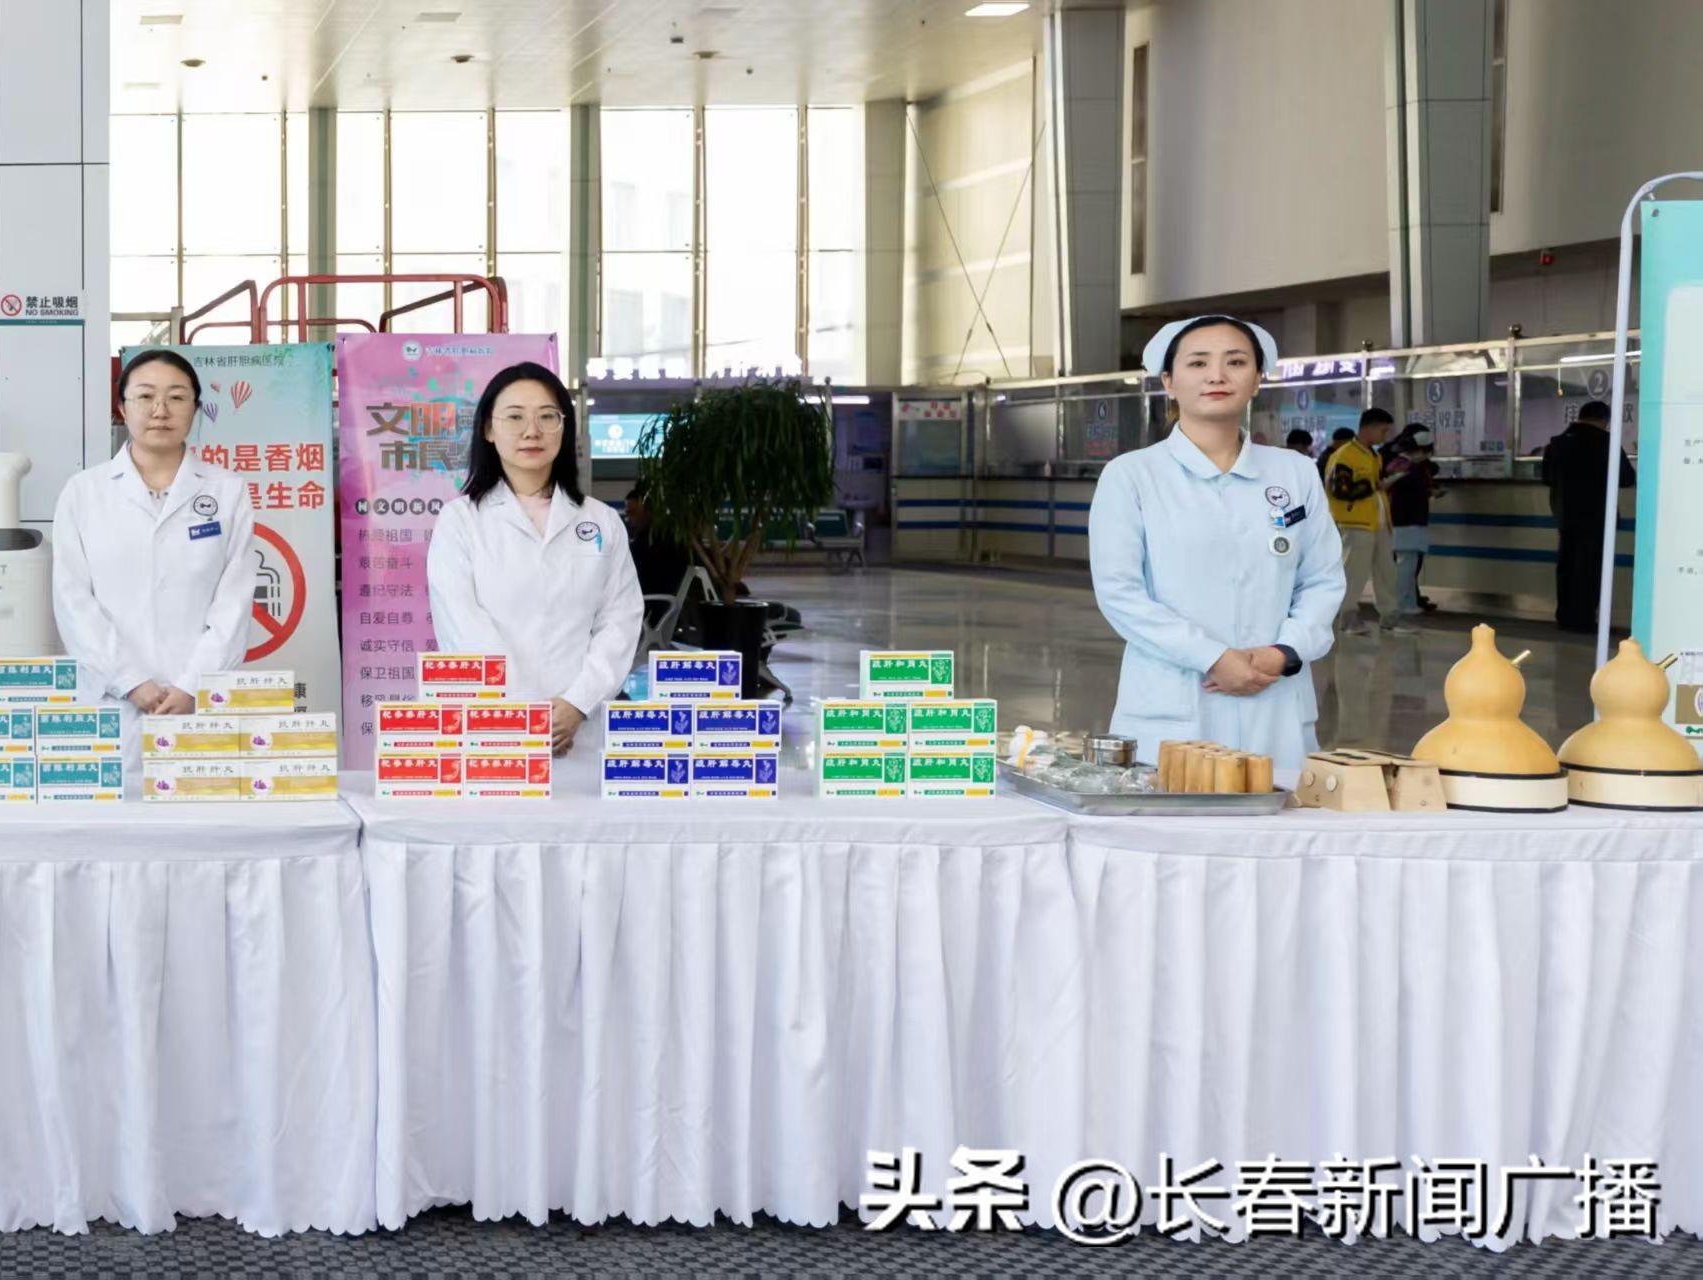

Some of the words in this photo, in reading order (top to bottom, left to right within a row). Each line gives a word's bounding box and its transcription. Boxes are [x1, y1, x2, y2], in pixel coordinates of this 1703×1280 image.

[26, 296, 79, 309] 禁止吸烟
[193, 353, 285, 368] 吉林省肝胆病医院
[191, 443, 325, 473] 的是香烟
[360, 612, 414, 625] 自爱自尊
[360, 639, 414, 652] 诚实守信
[360, 666, 415, 680] 保卫祖国
